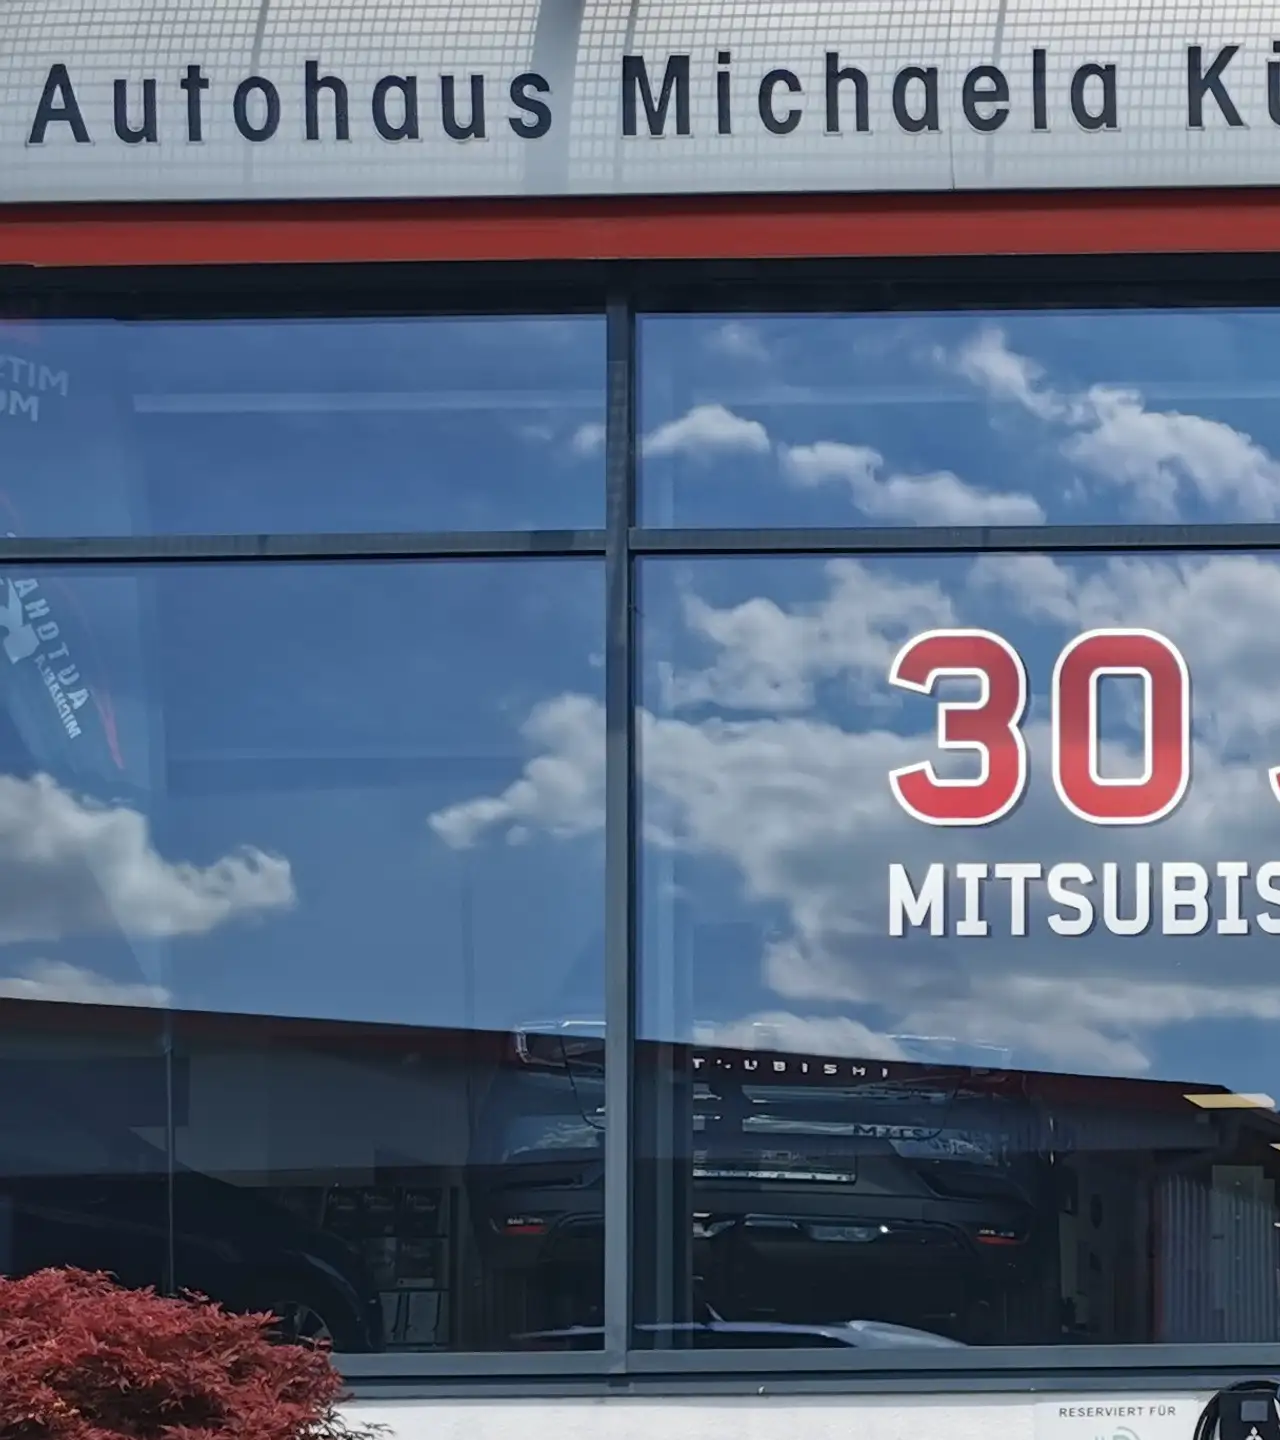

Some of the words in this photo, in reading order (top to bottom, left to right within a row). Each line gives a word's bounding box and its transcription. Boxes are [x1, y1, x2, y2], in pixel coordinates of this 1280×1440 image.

[27, 62, 555, 146] Autohaus
[620, 49, 1120, 139] Michaela
[889, 627, 1190, 826] 30
[1058, 1407, 1144, 1417] RESERVIERT
[1149, 1405, 1176, 1416] FÜR
